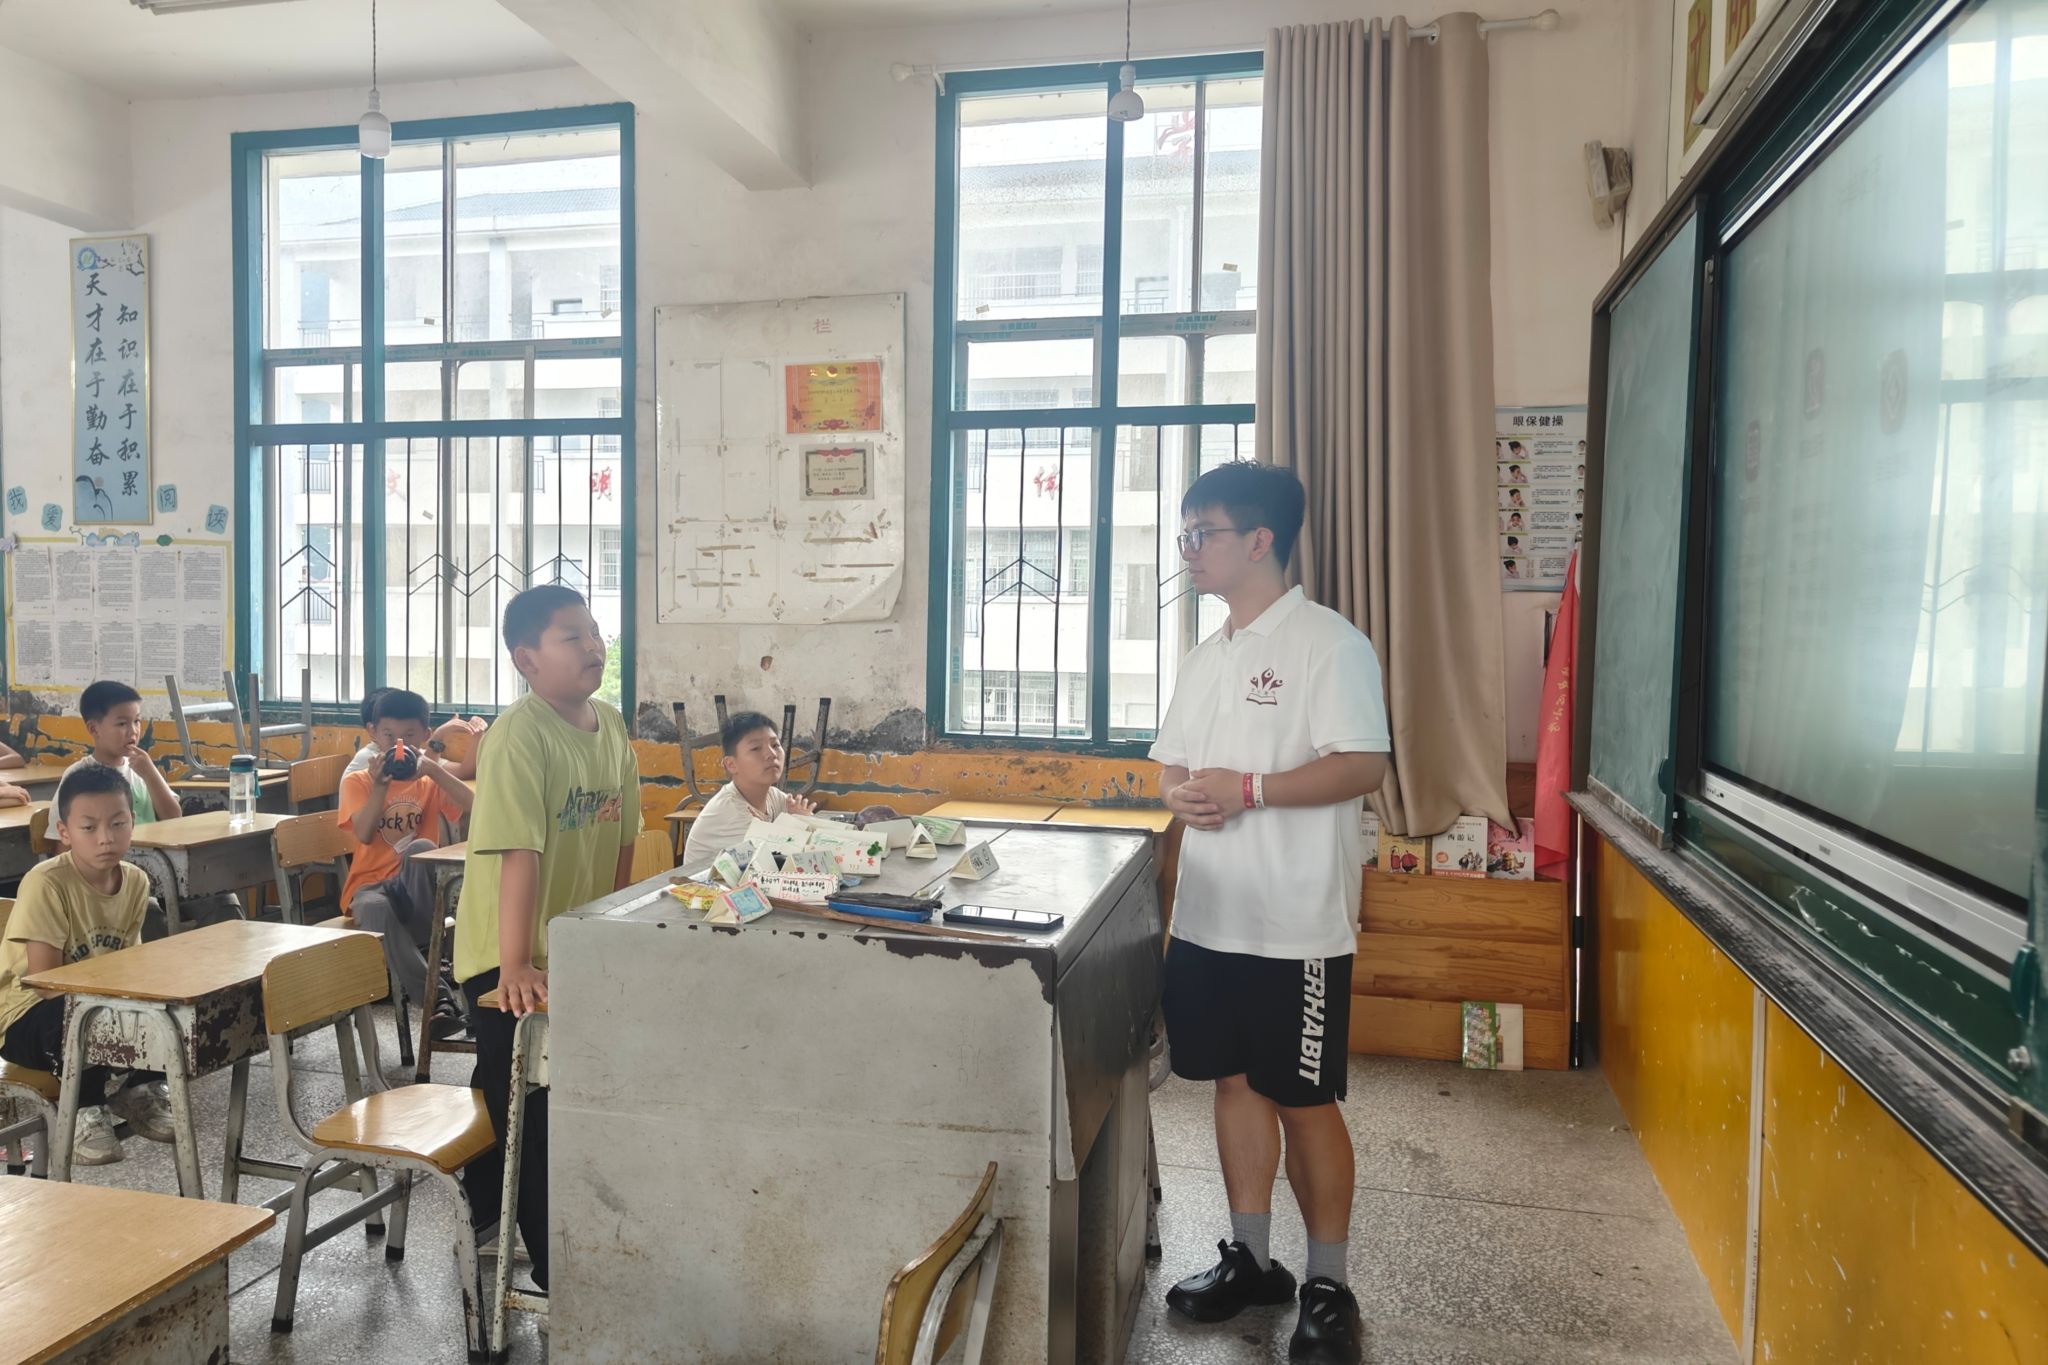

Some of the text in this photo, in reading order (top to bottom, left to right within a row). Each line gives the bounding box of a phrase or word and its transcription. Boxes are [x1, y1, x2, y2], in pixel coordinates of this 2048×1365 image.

[85, 272, 110, 466] 天才在于勤奋
[116, 304, 141, 496] 知识在于积累
[1512, 415, 1564, 428] 眼保健操
